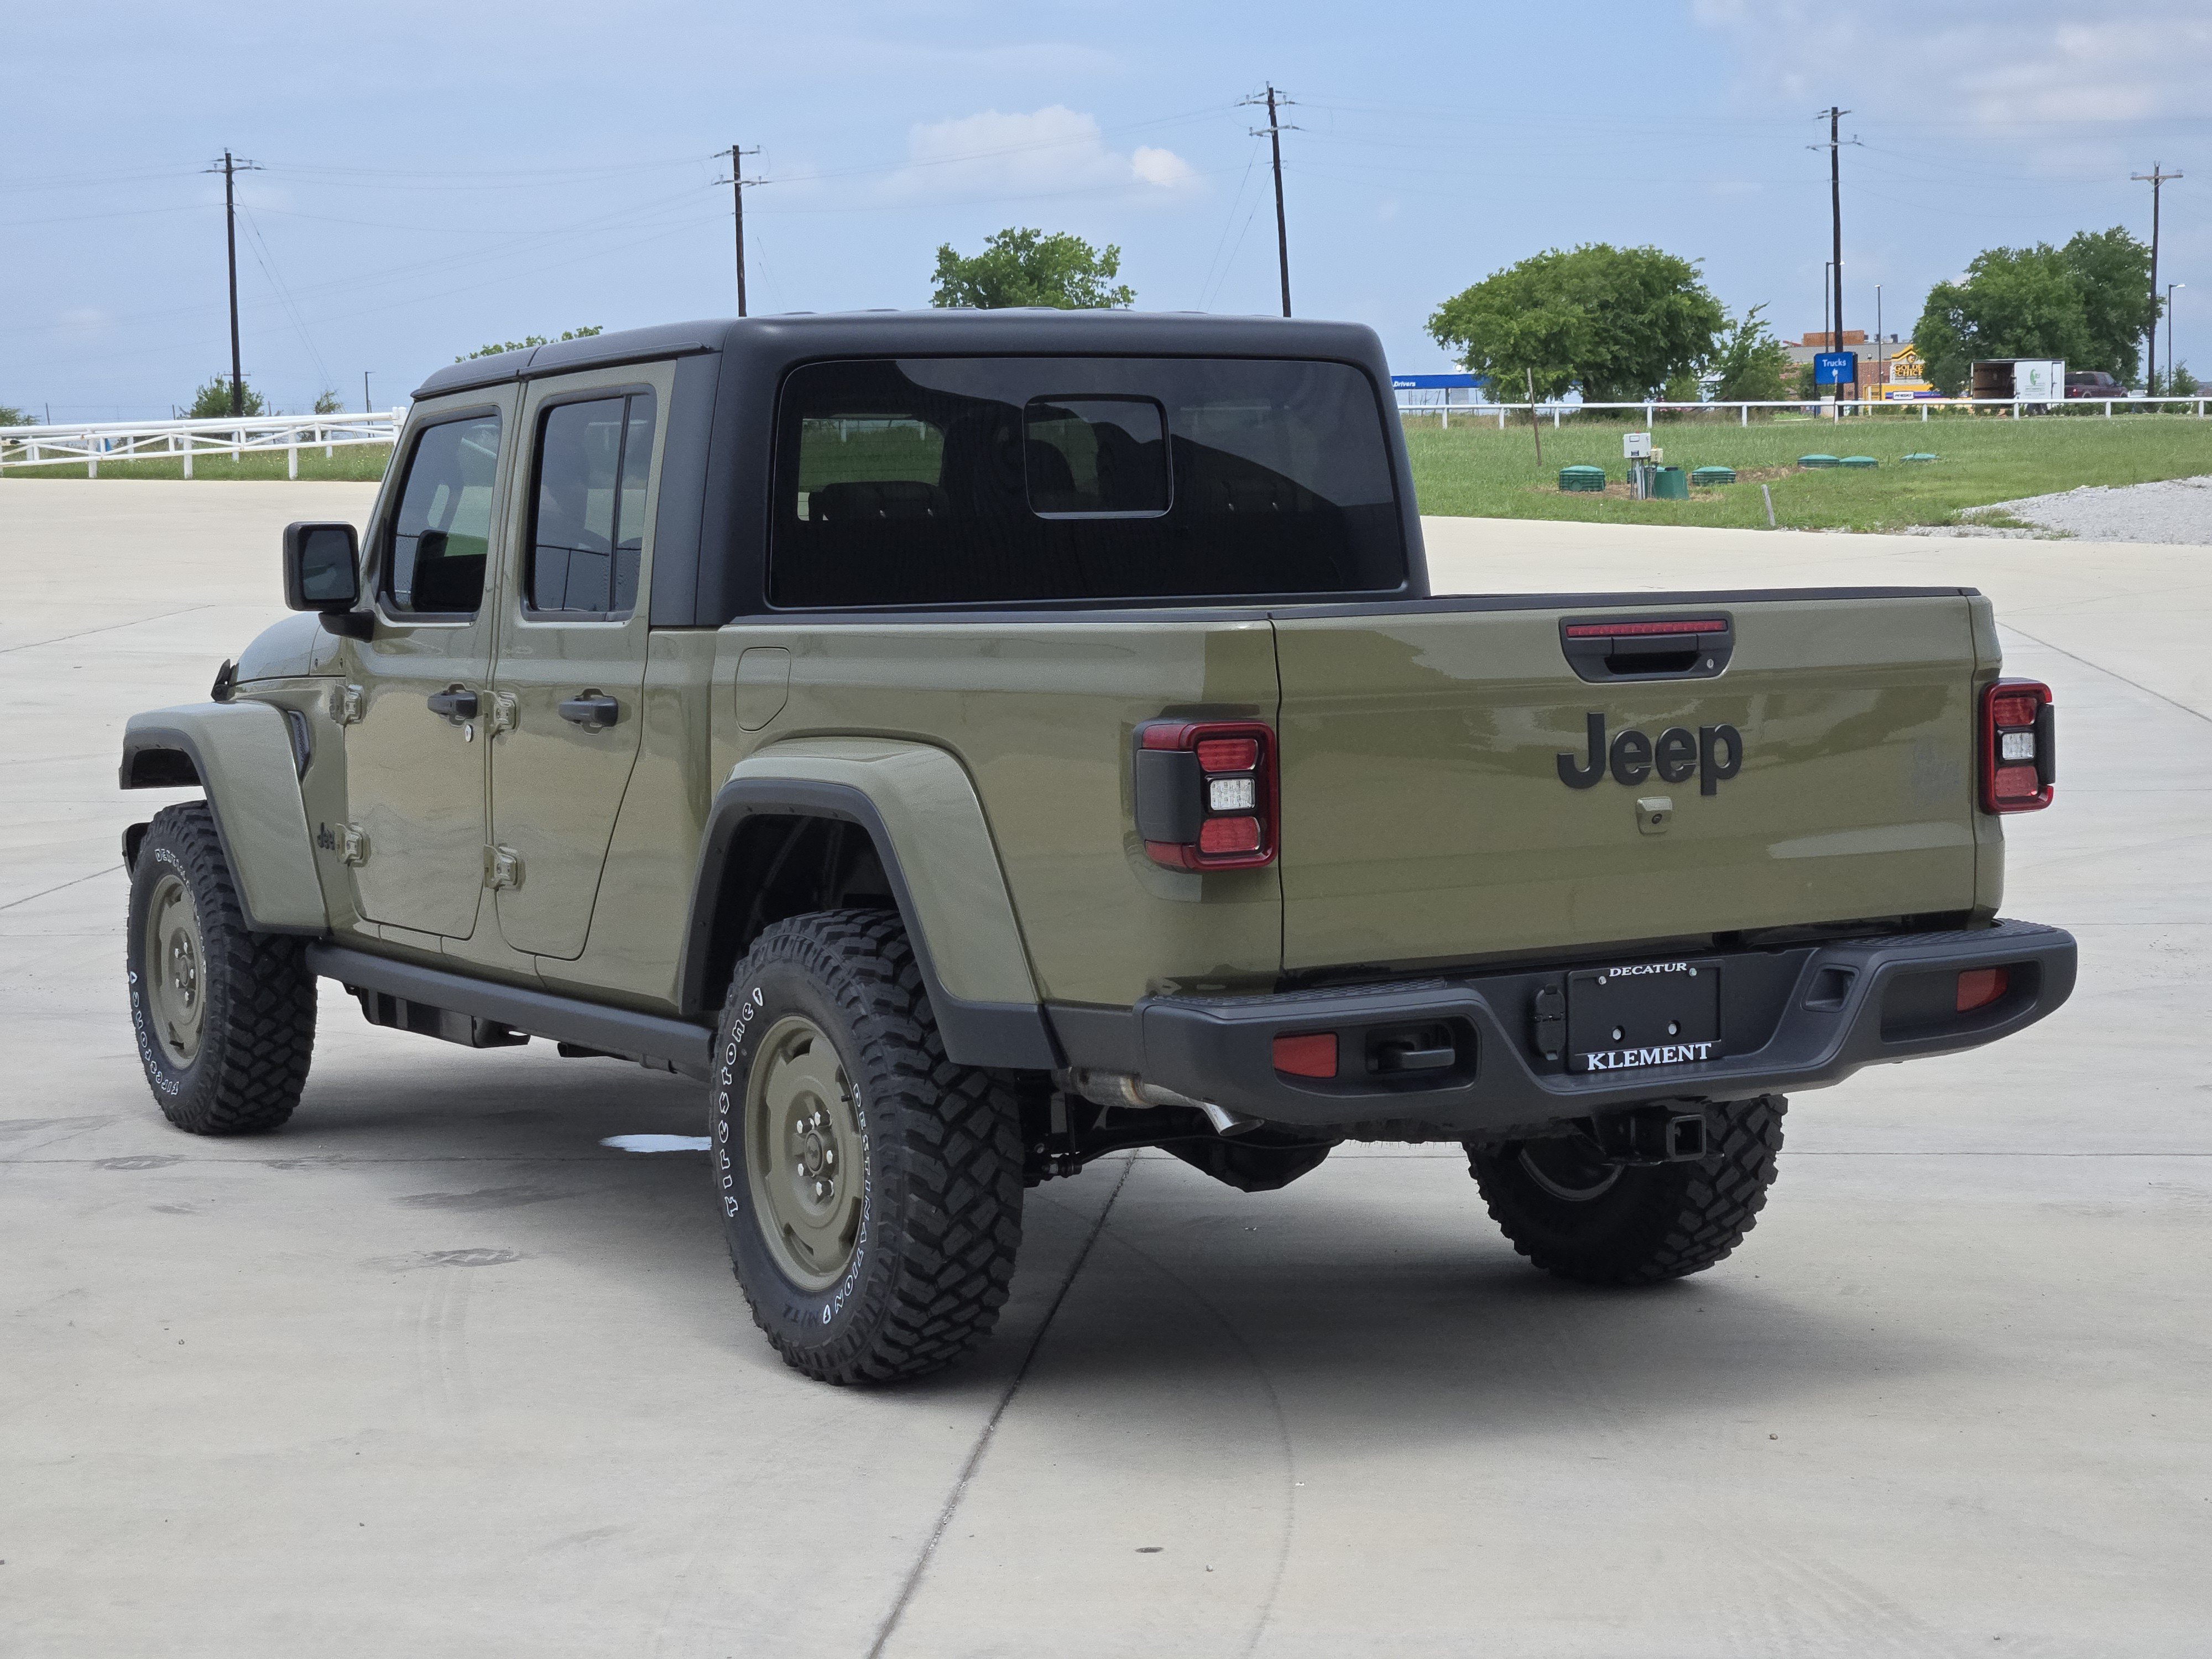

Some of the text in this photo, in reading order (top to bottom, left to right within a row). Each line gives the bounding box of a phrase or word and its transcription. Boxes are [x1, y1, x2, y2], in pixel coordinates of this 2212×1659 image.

[1822, 358, 1846, 367] Trucks
[1557, 712, 1743, 795] Jeep
[1609, 962, 1687, 977] DECATUR
[1587, 1043, 1712, 1071] KLEMENT
[834, 1083, 871, 1315] DESTINATION
